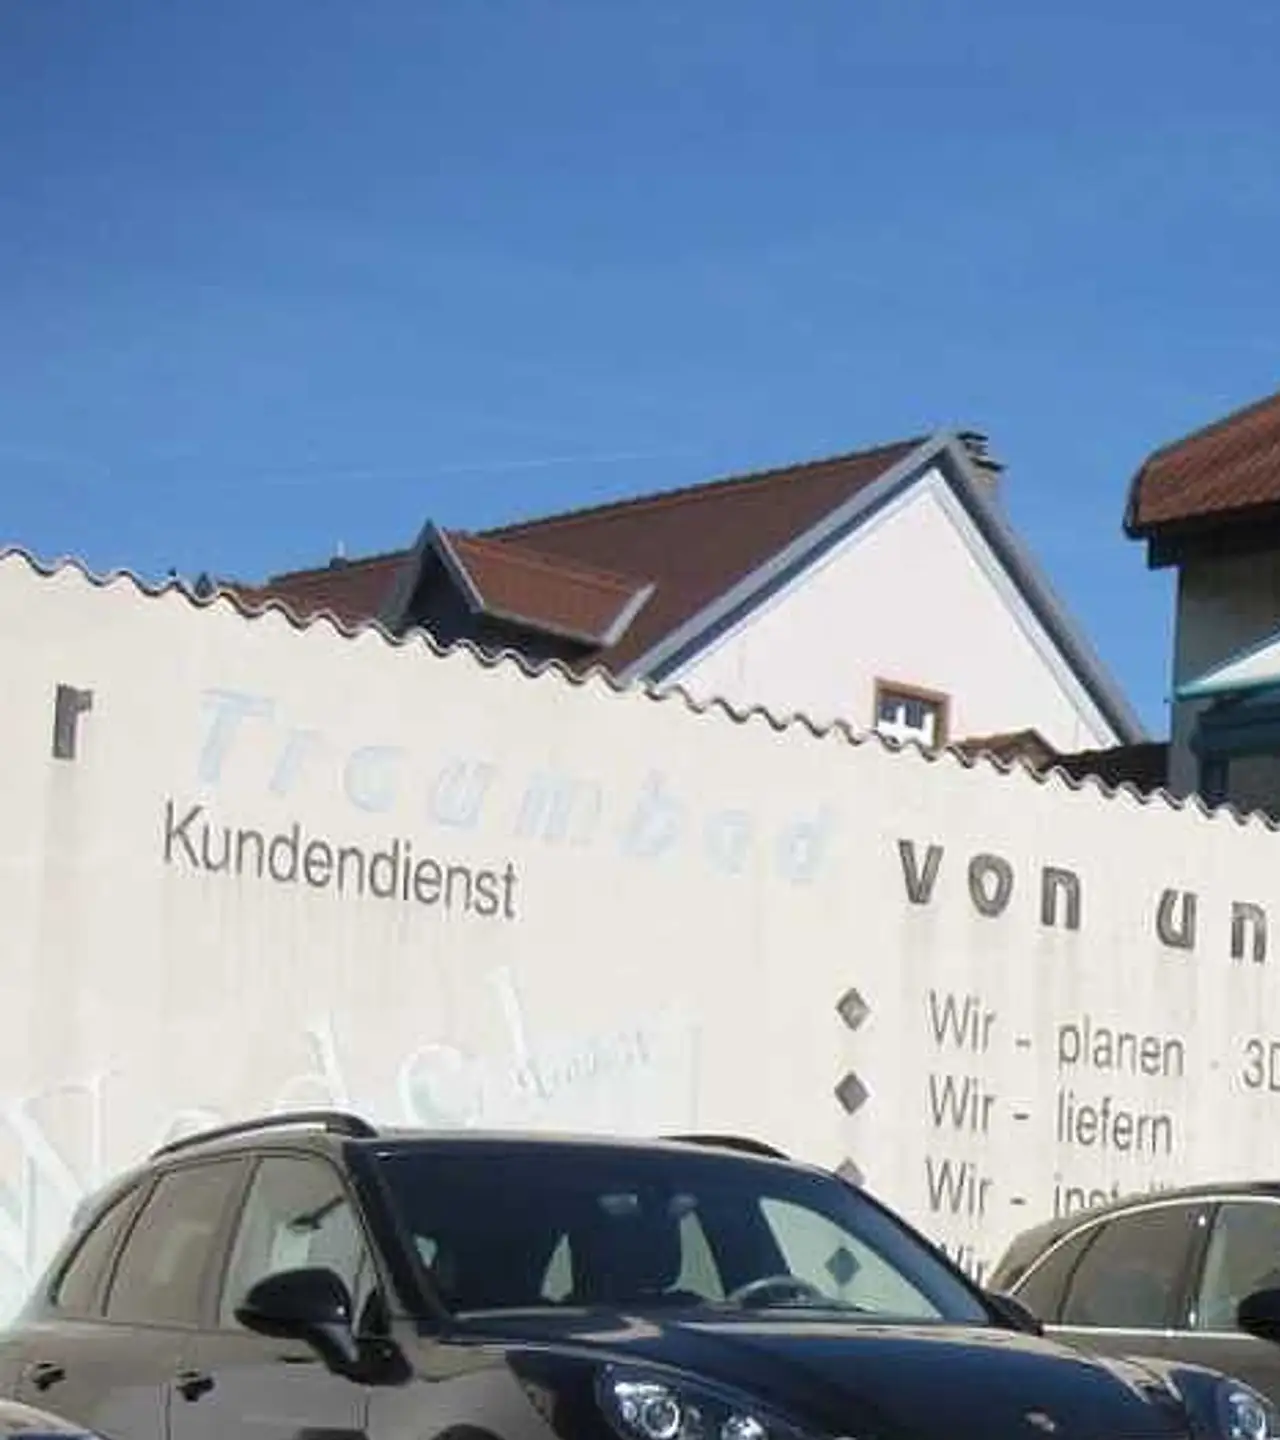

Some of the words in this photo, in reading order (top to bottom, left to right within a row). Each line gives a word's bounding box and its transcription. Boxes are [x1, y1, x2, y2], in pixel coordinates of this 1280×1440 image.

[163, 800, 519, 920] Kundendienst
[897, 838, 1082, 932] von
[929, 988, 998, 1051] Wir
[1057, 1018, 1185, 1079] planen
[928, 1073, 996, 1134] Wir
[1056, 1091, 1173, 1155] liefern
[925, 1157, 993, 1218] Wir
